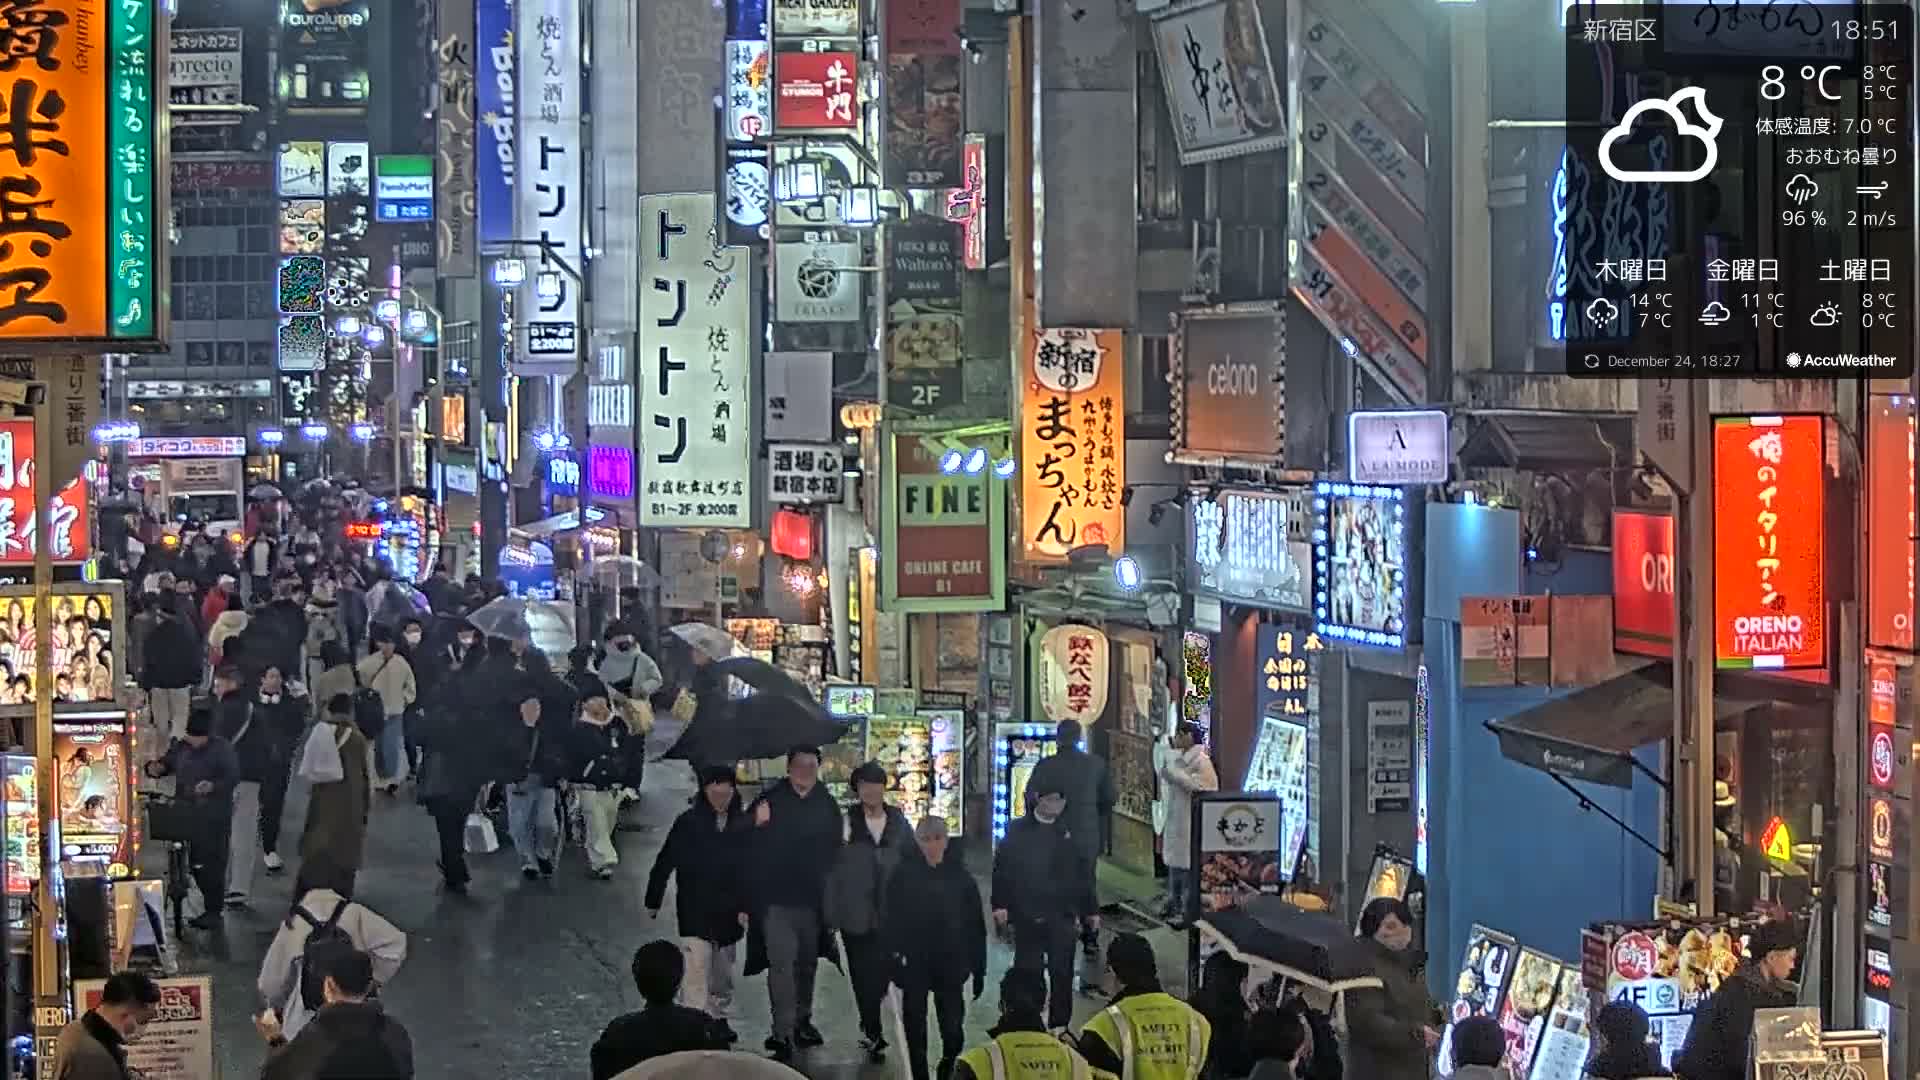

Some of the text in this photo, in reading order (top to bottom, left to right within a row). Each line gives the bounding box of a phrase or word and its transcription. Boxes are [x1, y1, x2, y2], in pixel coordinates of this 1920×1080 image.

[1308, 122, 1328, 142] 3
[380, 181, 431, 194] FamilyMart
[1307, 172, 1328, 191] 2
[653, 207, 687, 463] トントン
[707, 325, 730, 391] 焼とん
[1038, 339, 1097, 374] 新宿
[911, 385, 941, 405] 2F
[1387, 424, 1406, 451] A
[774, 450, 839, 472] 酒場心
[1035, 395, 1080, 545] まっちゃん
[773, 475, 838, 494] 新宿本店
[906, 484, 981, 514] FINE
[1748, 430, 1783, 605] 俺のイタリアン
[904, 559, 983, 576] ONLINE CAFE
[1734, 615, 1802, 634] ORENO
[1734, 633, 1803, 652] ITALIAN
[1141, 1023, 1181, 1034] SAFETY
